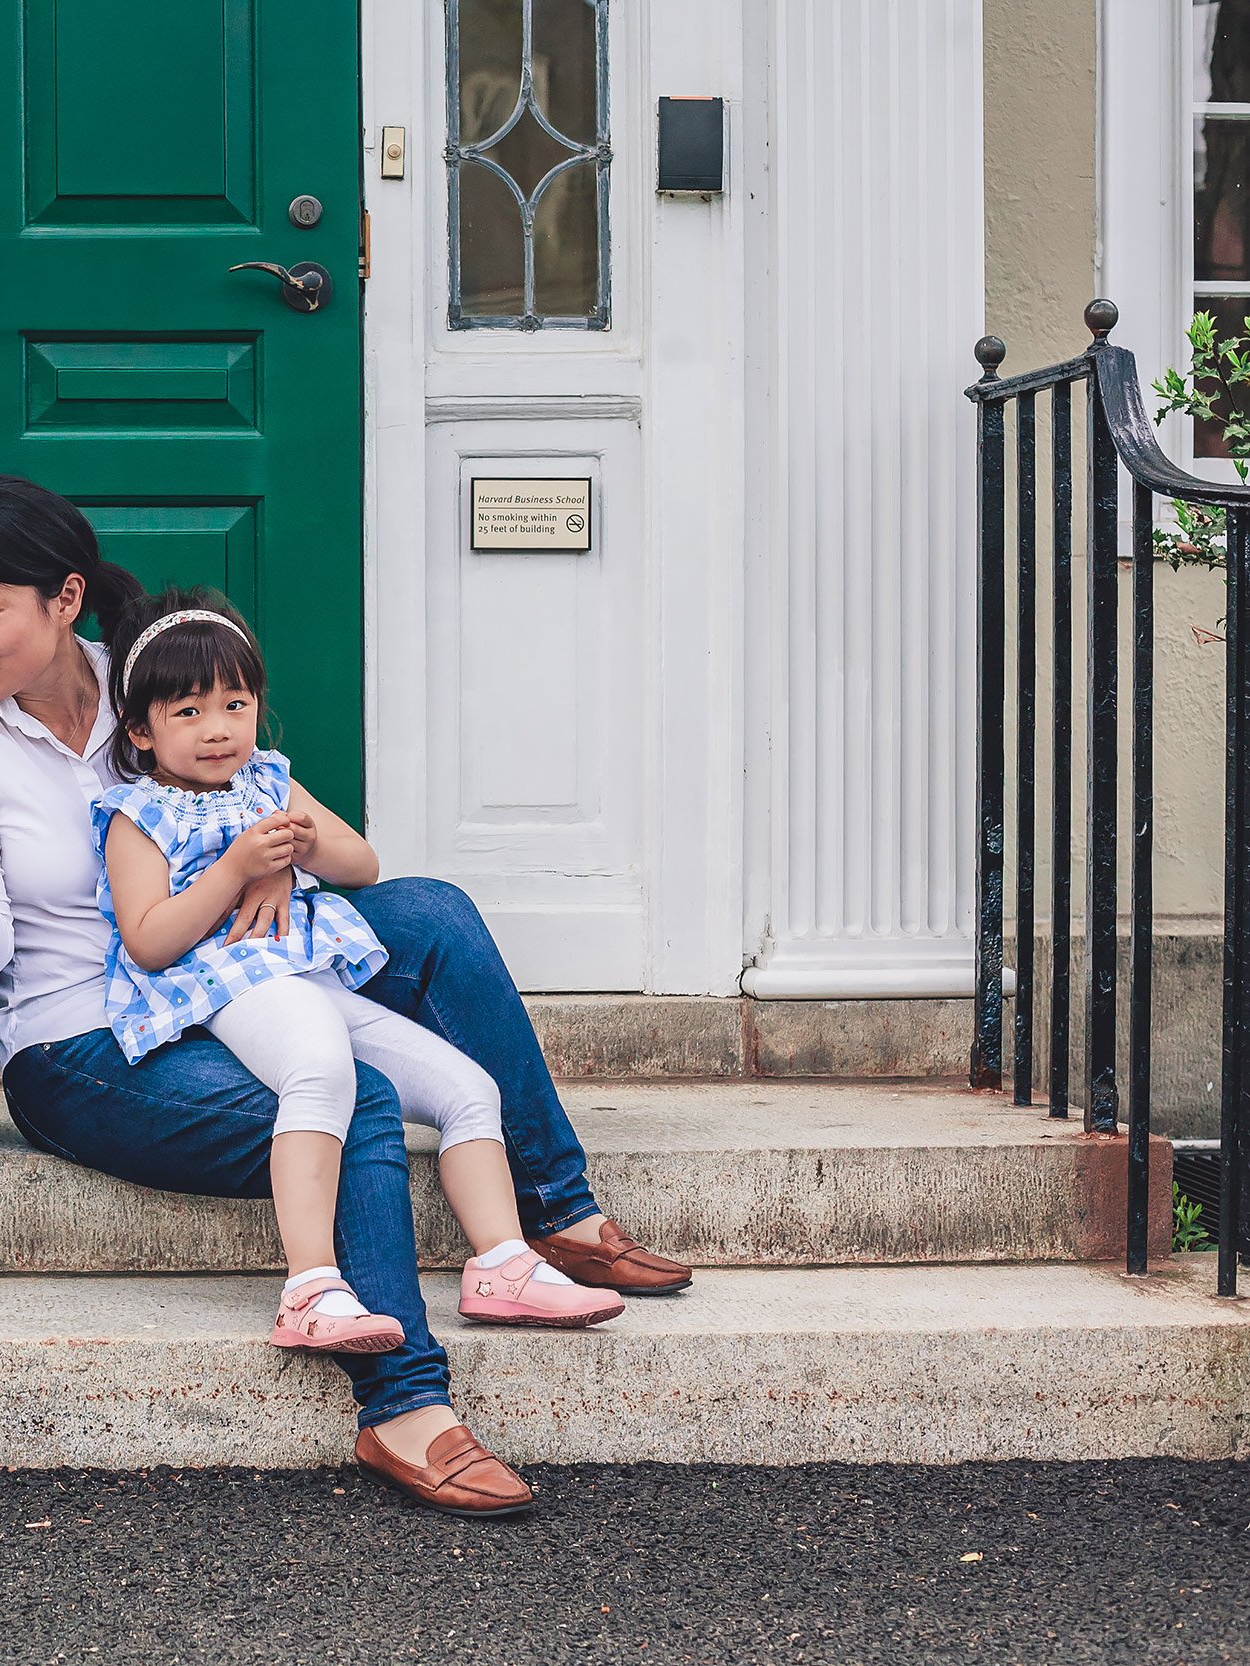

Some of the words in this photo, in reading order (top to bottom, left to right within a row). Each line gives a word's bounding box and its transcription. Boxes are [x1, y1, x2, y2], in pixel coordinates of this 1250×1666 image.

[478, 495, 513, 504] Harvard
[514, 495, 554, 504] Business
[555, 495, 585, 504] School
[478, 513, 490, 522] No
[492, 513, 529, 523] smoking
[530, 513, 558, 522] within
[478, 526, 489, 534] 25
[490, 525, 507, 533] feet
[509, 525, 519, 533] of
[520, 525, 555, 535] building
